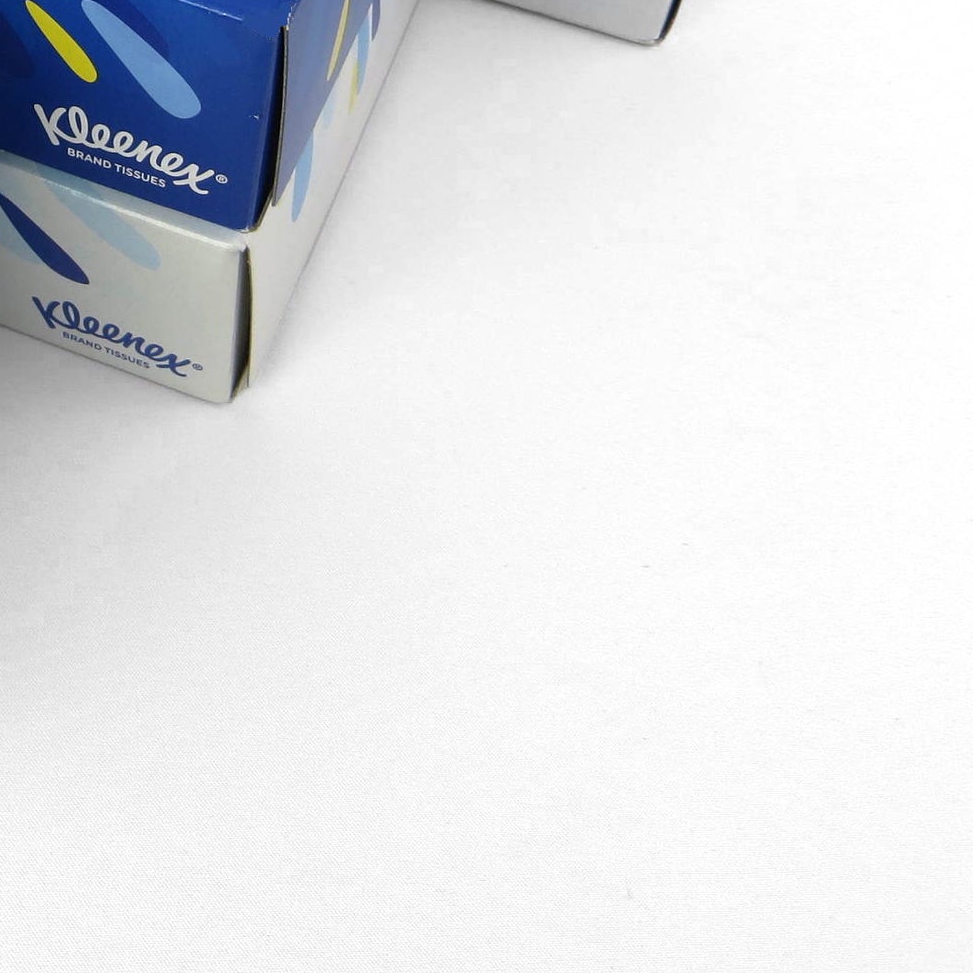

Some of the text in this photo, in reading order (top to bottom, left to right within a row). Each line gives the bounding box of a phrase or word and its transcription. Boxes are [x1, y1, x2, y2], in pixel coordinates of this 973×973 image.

[67, 147, 166, 188] BRAND TISSUES
[62, 331, 151, 369] BRAND TISSUES
